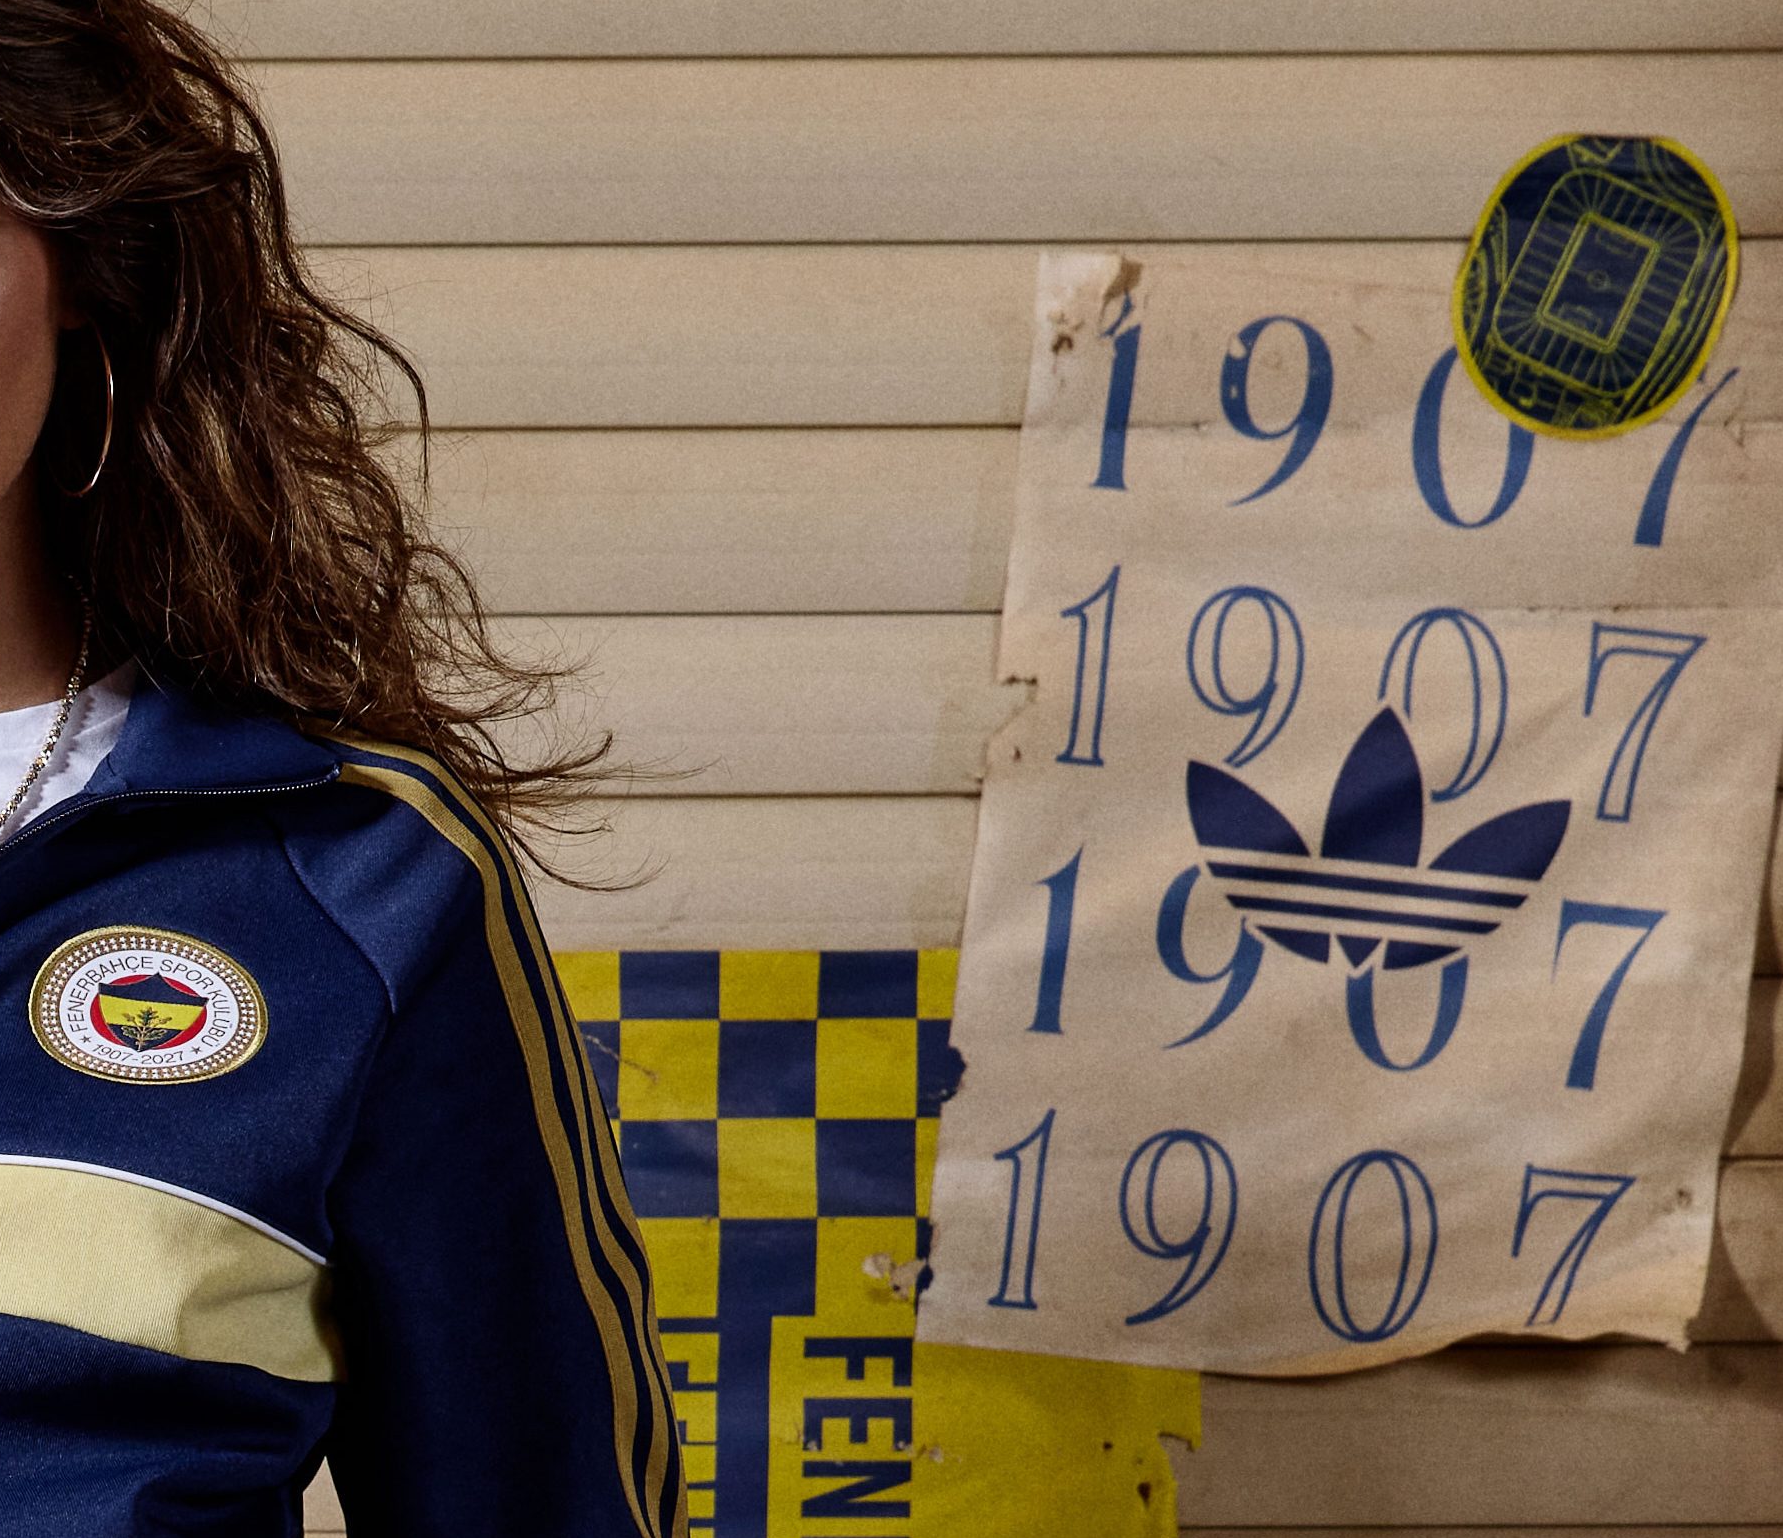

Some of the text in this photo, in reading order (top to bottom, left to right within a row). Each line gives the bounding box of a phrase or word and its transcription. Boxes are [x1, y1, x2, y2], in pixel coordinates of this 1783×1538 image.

[1057, 563, 1708, 824] 1907
[66, 955, 233, 1048] FENERBAHÇE SPOR KULÜBÜ
[91, 1043, 185, 1066] 1907-2027
[1025, 843, 1667, 1092] 1907
[987, 1107, 1637, 1344] 1907
